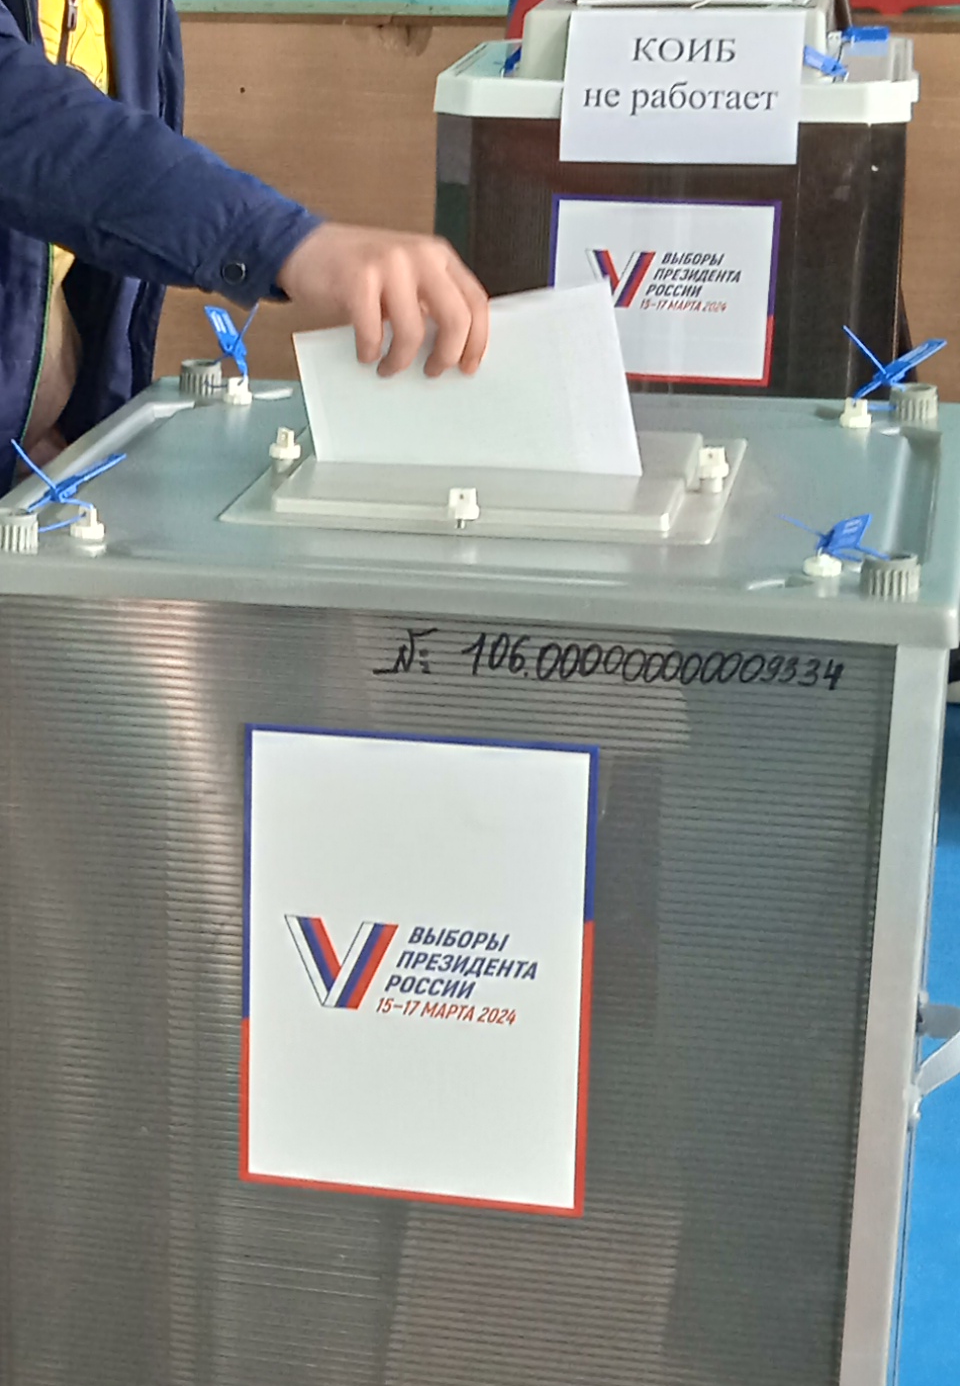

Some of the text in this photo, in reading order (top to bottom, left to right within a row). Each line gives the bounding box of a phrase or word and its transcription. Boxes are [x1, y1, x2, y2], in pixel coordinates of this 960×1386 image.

[630, 36, 737, 64] КОИБ
[582, 80, 779, 116] не работает
[661, 251, 725, 267] ВЫБОРЫ
[653, 268, 742, 284] ПРЕЗИДЕНТА
[645, 284, 703, 298] РОССИИ
[667, 299, 701, 312] МАРТА
[701, 300, 728, 313] 2024
[408, 926, 510, 952] ВЫБОРЫ
[395, 950, 538, 980] ПРЕЗИДЕНТА
[384, 974, 476, 1000] РОССИИ
[420, 1001, 477, 1023] МАРТА
[476, 1005, 517, 1026] 2024
